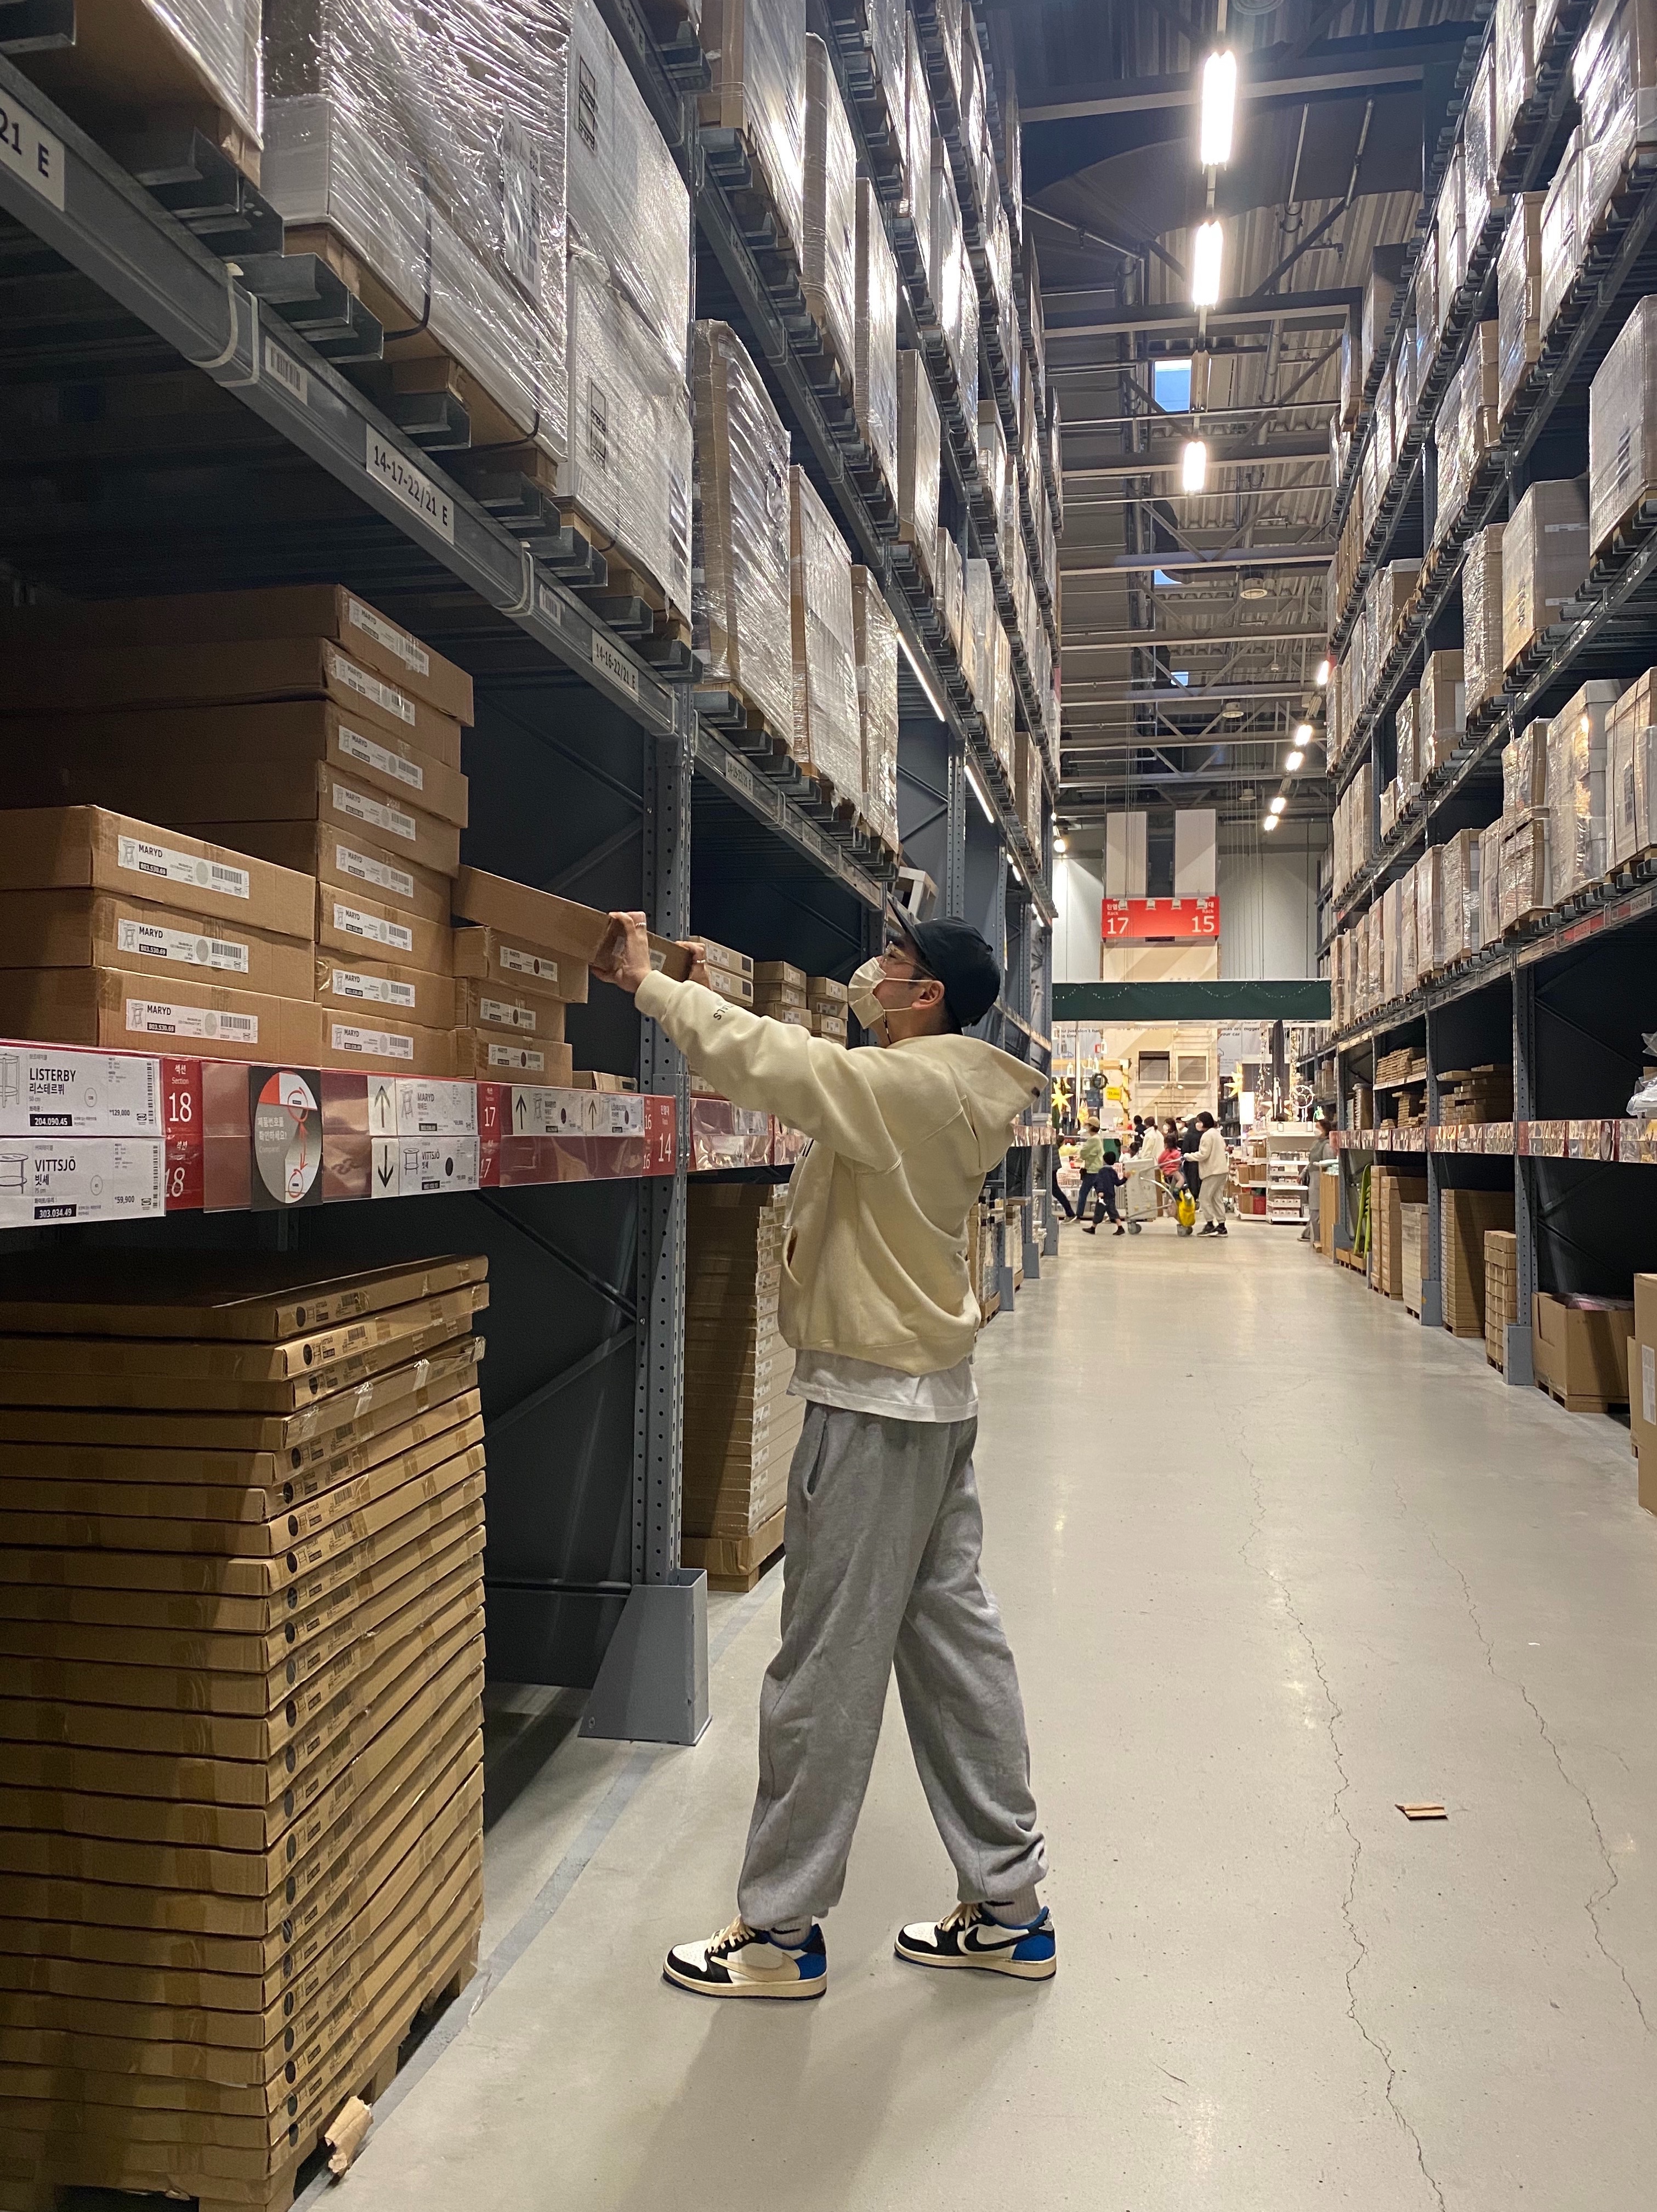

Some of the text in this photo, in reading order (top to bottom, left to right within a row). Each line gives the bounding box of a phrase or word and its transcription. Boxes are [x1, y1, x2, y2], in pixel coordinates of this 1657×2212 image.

[38, 142, 49, 178] E
[374, 445, 448, 526] 14-17-22/21 E
[596, 643, 635, 689] 14-16-22/21 E
[138, 844, 163, 858] MARYD
[345, 910, 360, 920] MARYD
[1107, 917, 1129, 935] 17
[1191, 915, 1215, 933] 15
[139, 926, 163, 938] MARYD
[140, 945, 166, 955] 803.530.69
[344, 974, 360, 983] MARYD
[147, 1005, 172, 1015] MARYD
[344, 1028, 360, 1037] MARYD
[30, 1068, 76, 1082] LISTERBY
[175, 1064, 186, 1075] 섹션
[171, 1077, 189, 1085] Section
[417, 1093, 435, 1102] MARYD
[169, 1091, 192, 1122] 18
[34, 1117, 68, 1126] 204.090.45
[484, 1106, 496, 1127] 17
[645, 1114, 652, 1130] 16
[658, 1133, 672, 1162] 14
[35, 1156, 76, 1172] VITTSJÖ
[479, 1158, 492, 1179] 17
[643, 1153, 651, 1169] 16
[164, 1167, 185, 1198] 18
[39, 1208, 72, 1218] 303.034.49
